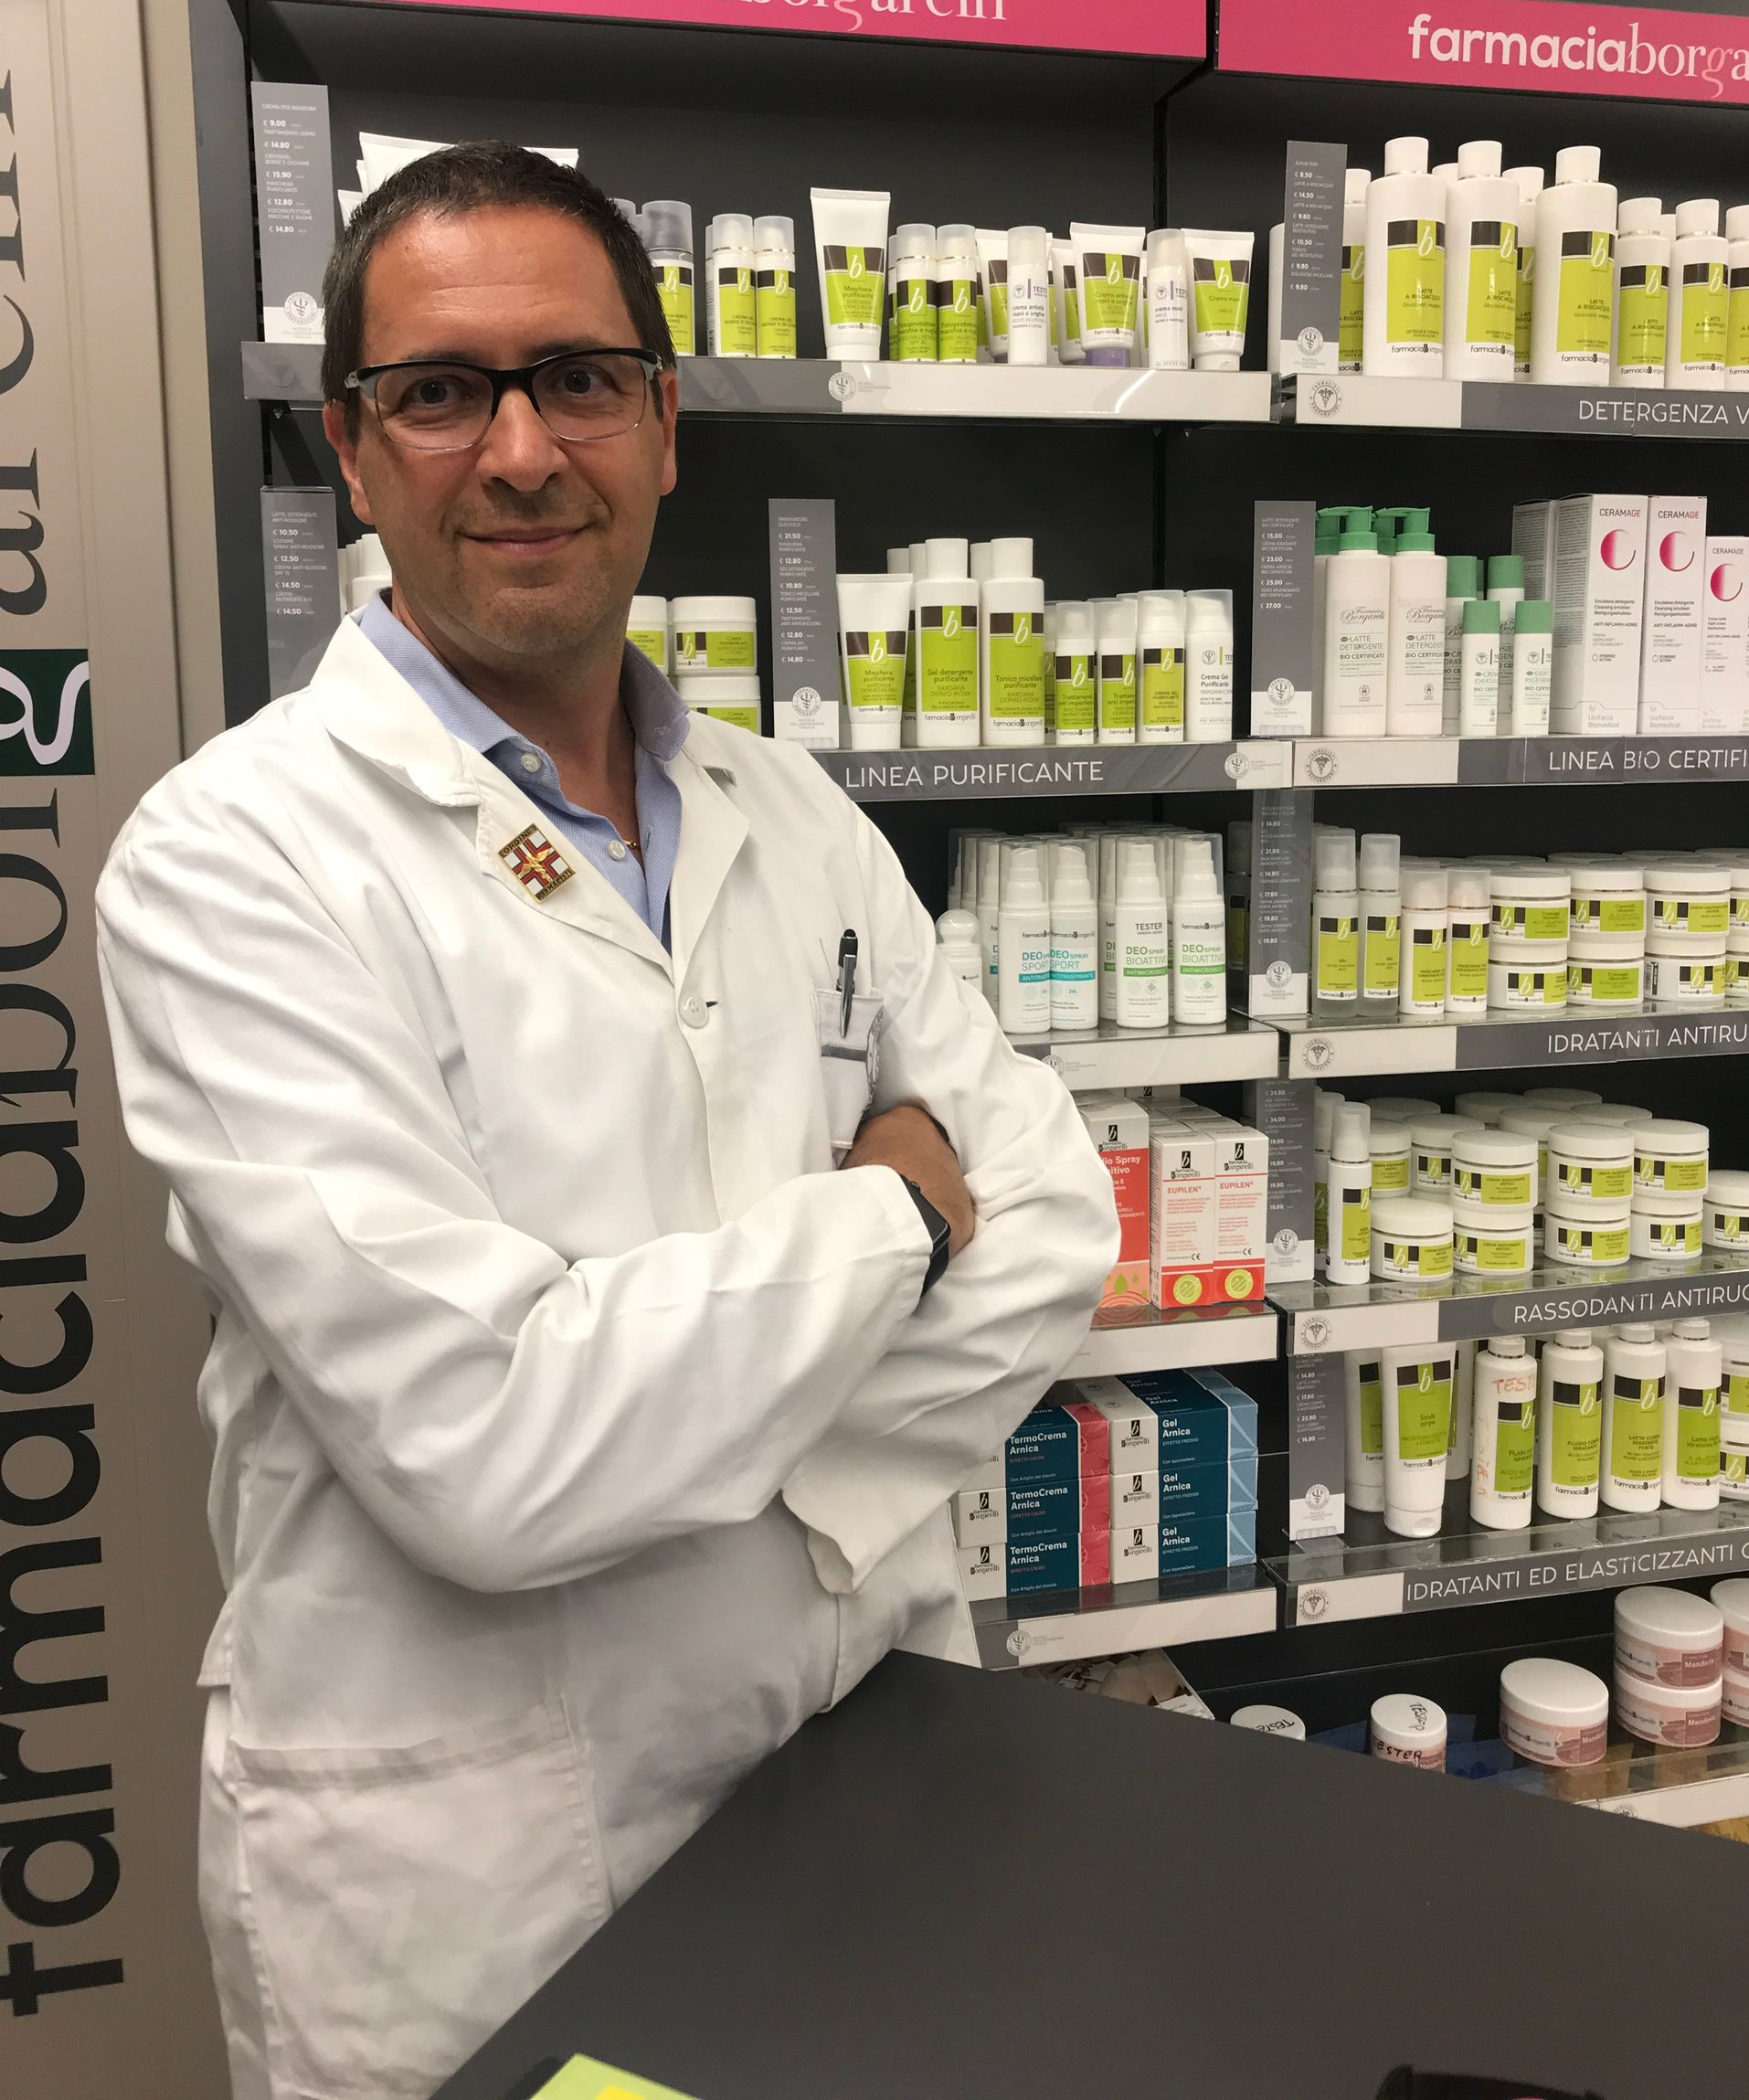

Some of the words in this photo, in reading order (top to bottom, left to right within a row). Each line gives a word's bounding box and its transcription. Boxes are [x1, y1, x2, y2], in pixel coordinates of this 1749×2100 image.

[1579, 399, 1729, 425] DETERGENZA
[1600, 509, 1640, 517] CERAMAGE
[1549, 750, 1614, 771] LINEA
[1624, 749, 1660, 770] BIO
[1669, 749, 1747, 769] CERTIFI
[845, 766, 922, 789] LINEA
[934, 760, 1104, 786] PURIFICANTE
[504, 830, 532, 854] ORDINE
[1023, 952, 1042, 960] DEO
[1548, 1029, 1659, 1054] IDRATANTI
[1667, 1024, 1748, 1047] ANTIRU
[1116, 1156, 1140, 1166] Spray
[1513, 1293, 1654, 1324] RASSODANTI
[1492, 1374, 1535, 1394] TEST
[1162, 1419, 1177, 1427] Gel
[1162, 1428, 1190, 1437] Arnica
[1010, 1432, 1066, 1444] TermoCrema
[1010, 1446, 1038, 1454] Arnica
[1163, 1474, 1177, 1482] Gel
[1163, 1483, 1191, 1492] Arnica
[1011, 1487, 1067, 1500] TermoCrema
[1012, 1501, 1040, 1510] Arnica
[1162, 1527, 1177, 1536] Gel
[1162, 1537, 1190, 1546] Arnica
[1011, 1543, 1067, 1554] TermoCrema
[1011, 1556, 1039, 1564] Arnica
[1407, 1571, 1520, 1602] IDRATANTI
[1530, 1567, 1556, 1586] ED
[1566, 1545, 1733, 1582] ELASTICIZZANTI
[1256, 1718, 1295, 1733] TESTE
